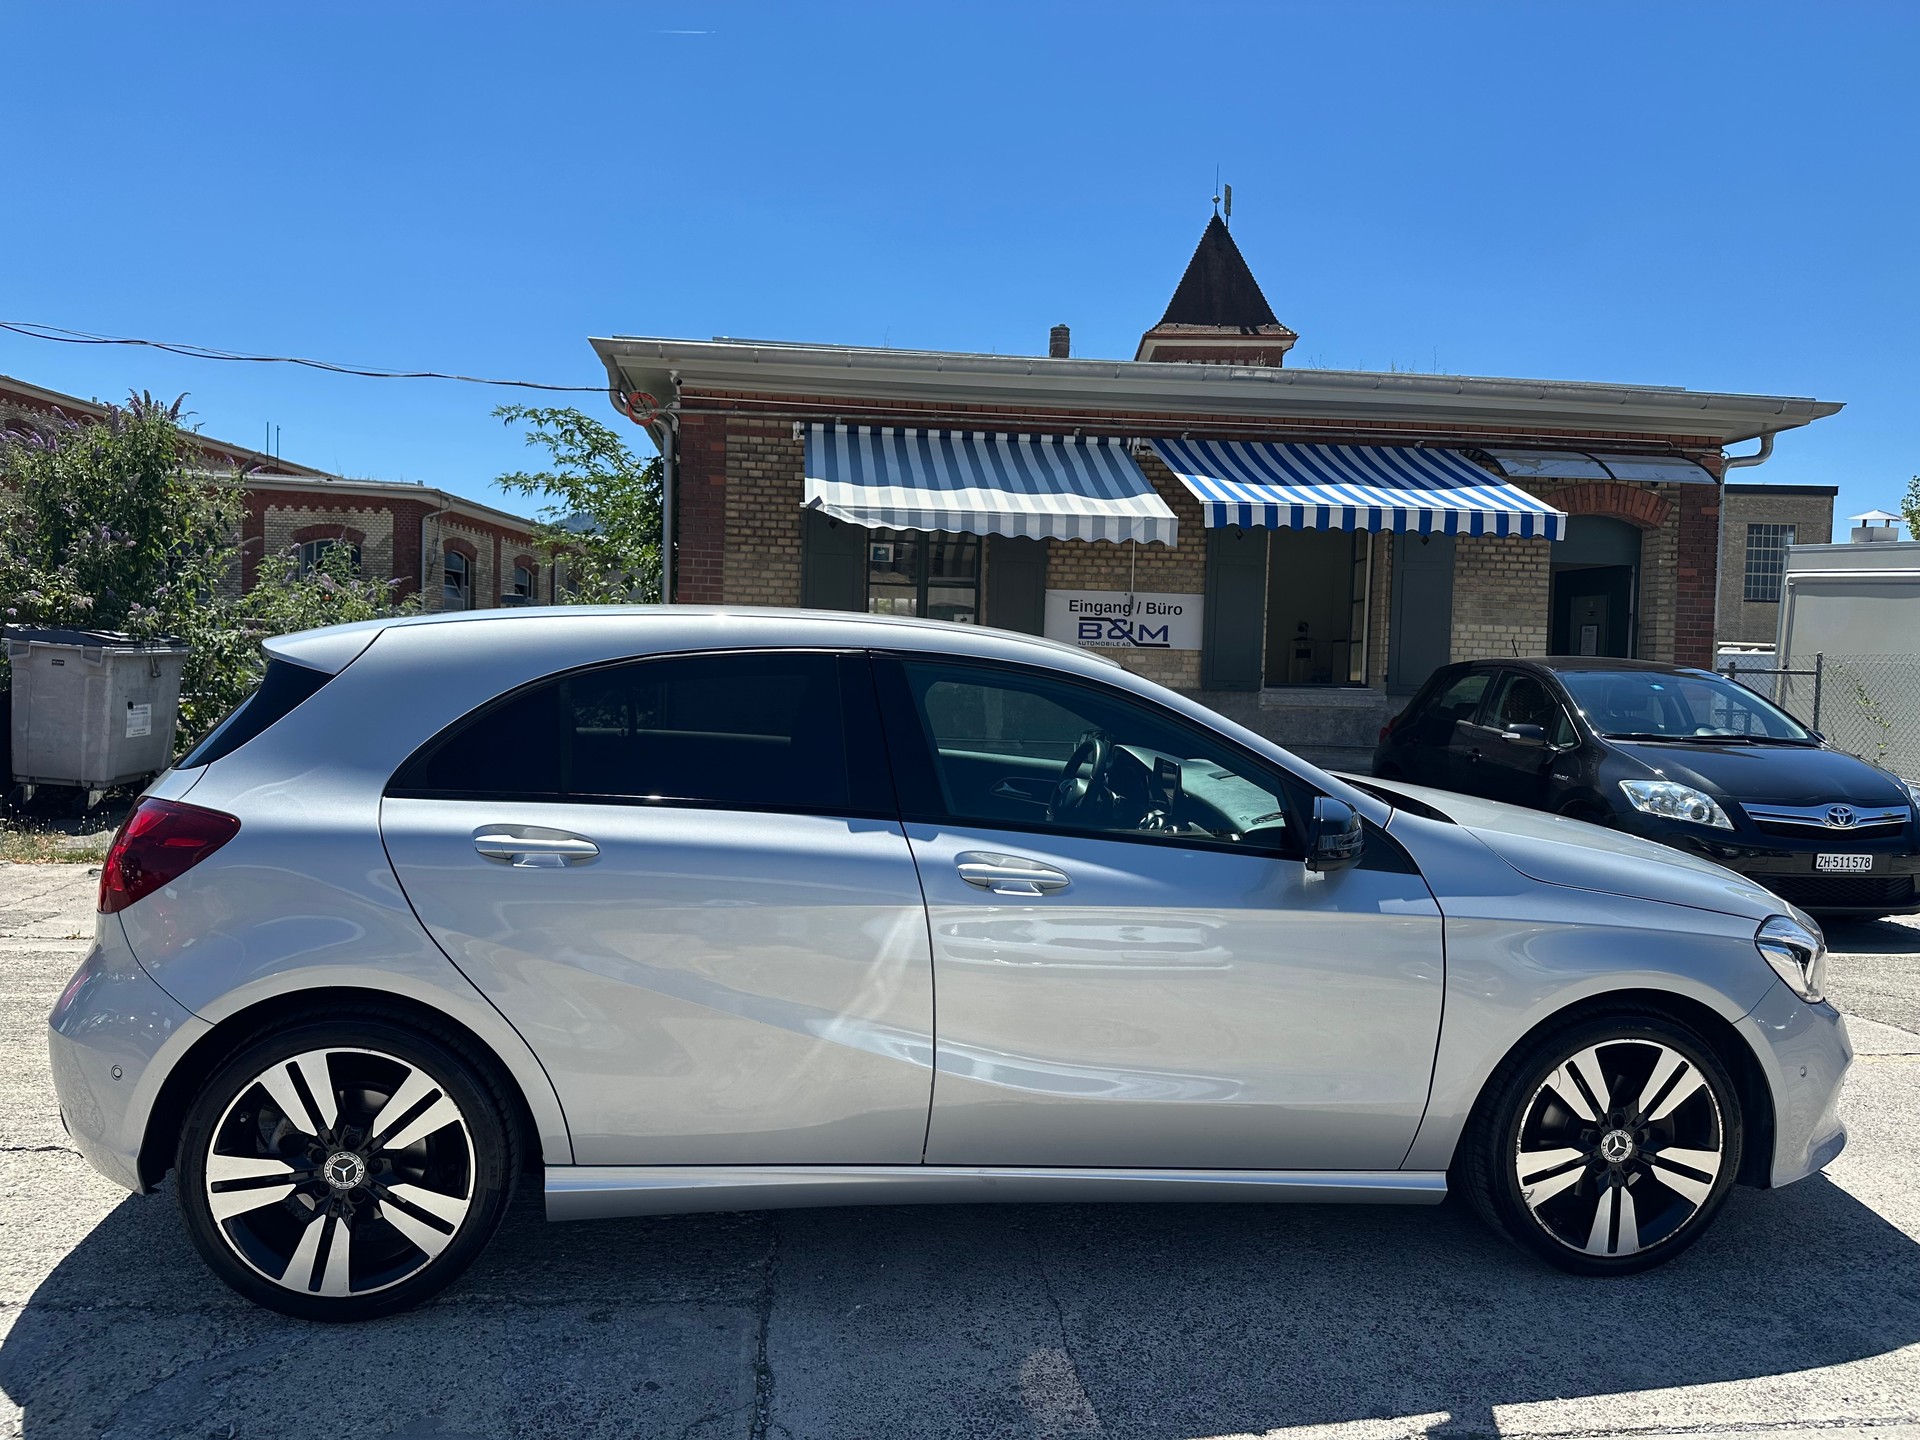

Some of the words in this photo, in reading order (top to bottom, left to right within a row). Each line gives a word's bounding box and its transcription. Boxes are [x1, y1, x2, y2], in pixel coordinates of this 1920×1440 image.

[1069, 599, 1132, 617] Eingang
[1136, 601, 1142, 615] /
[1146, 602, 1183, 616] Büro
[1078, 618, 1169, 642] B&M
